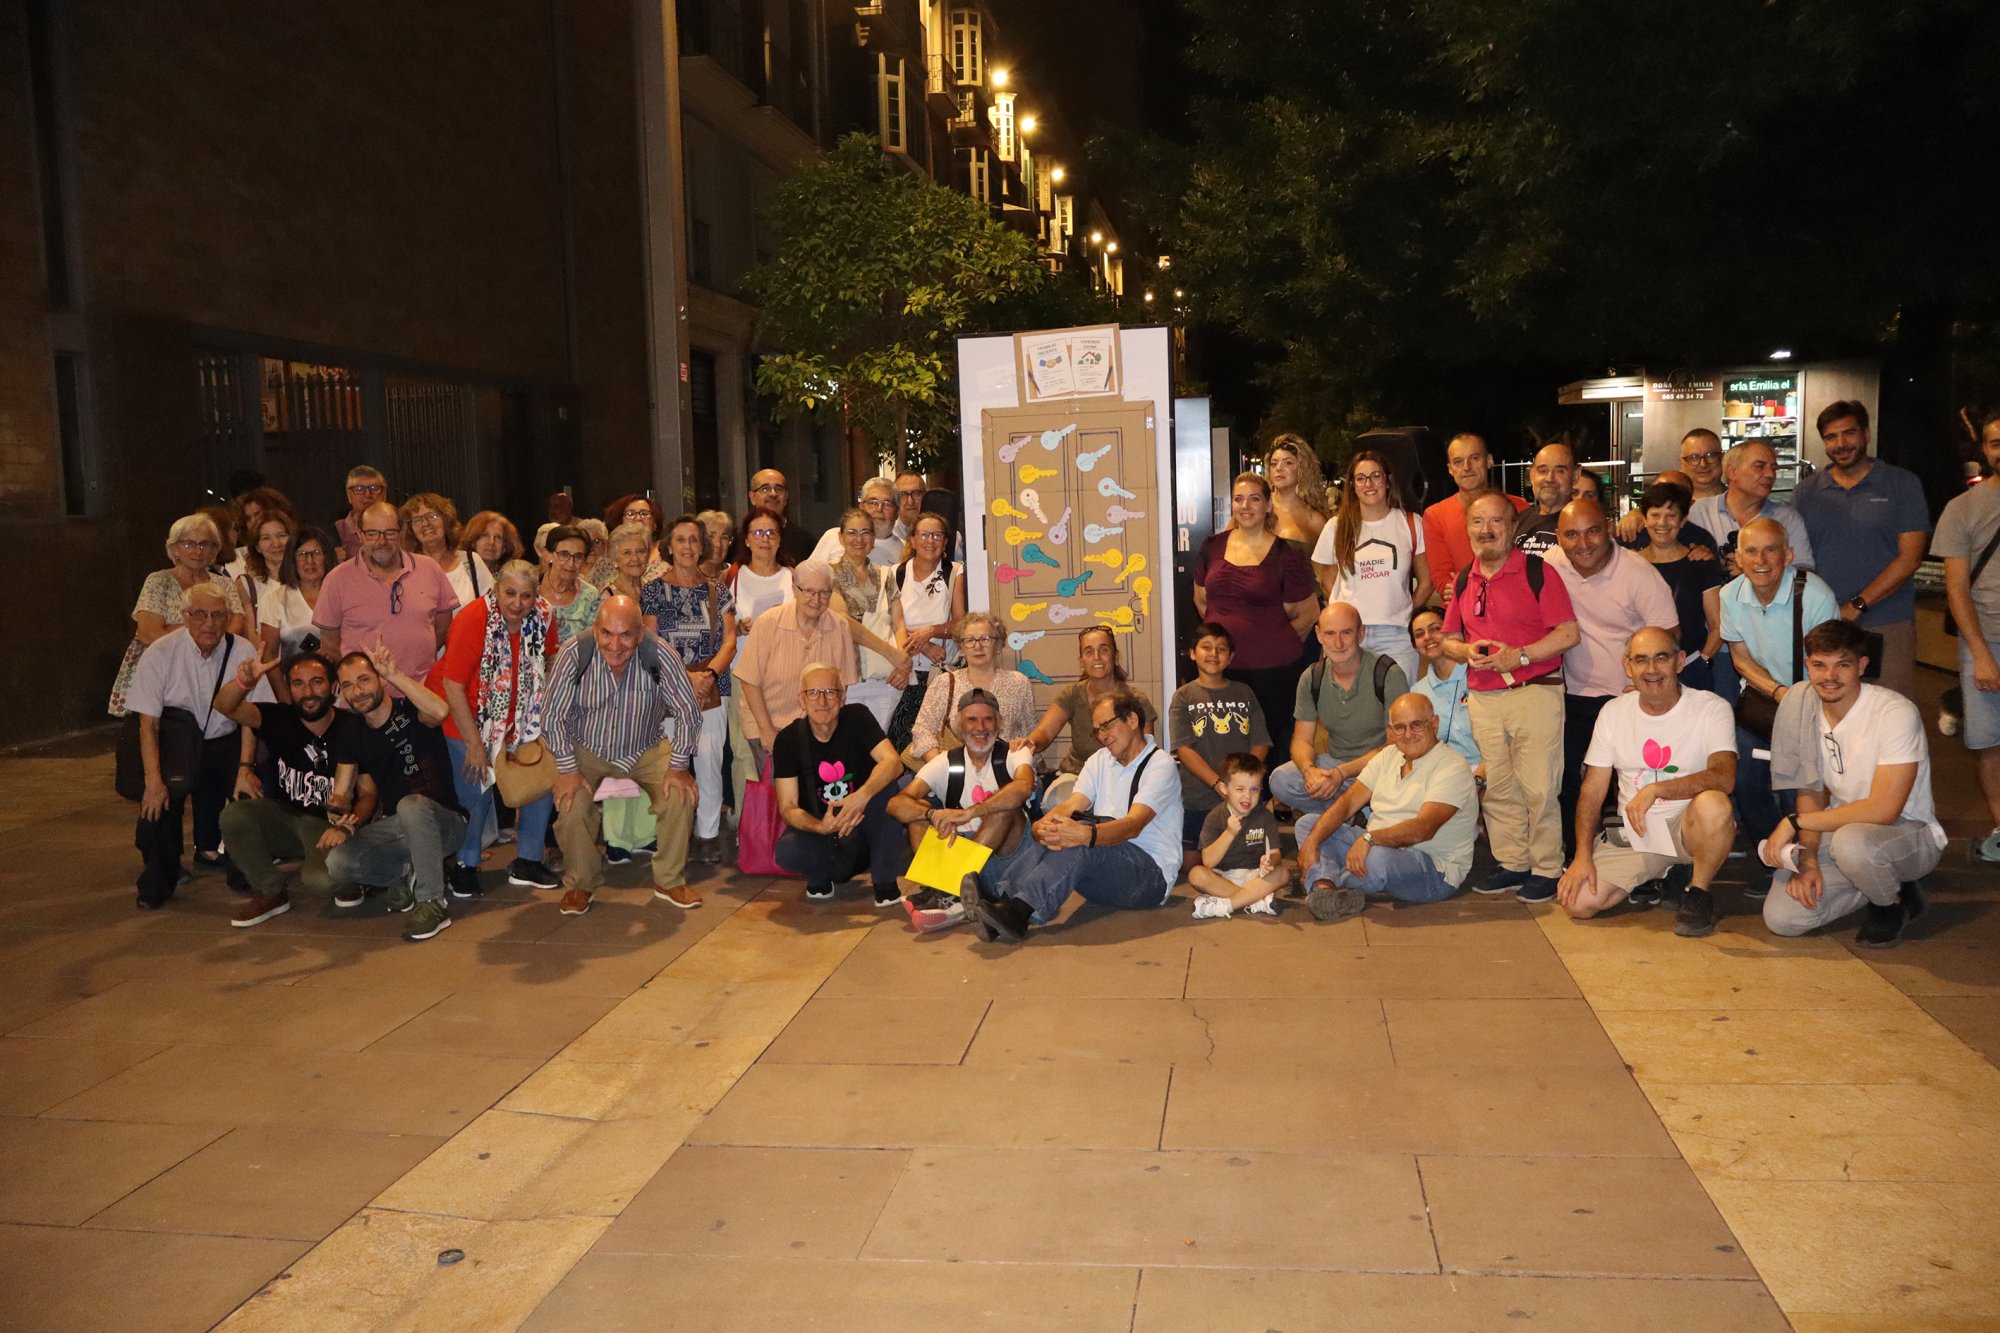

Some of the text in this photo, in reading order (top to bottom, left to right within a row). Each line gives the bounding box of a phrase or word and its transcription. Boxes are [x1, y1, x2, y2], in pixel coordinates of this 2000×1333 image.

[1653, 381, 1672, 389] DOÑA
[1749, 380, 1779, 390] Emilia
[1360, 559, 1385, 567] NADIE
[1360, 566, 1374, 574] SIN
[1361, 570, 1390, 580] HOGAR
[1188, 700, 1250, 711] POKÉMO
